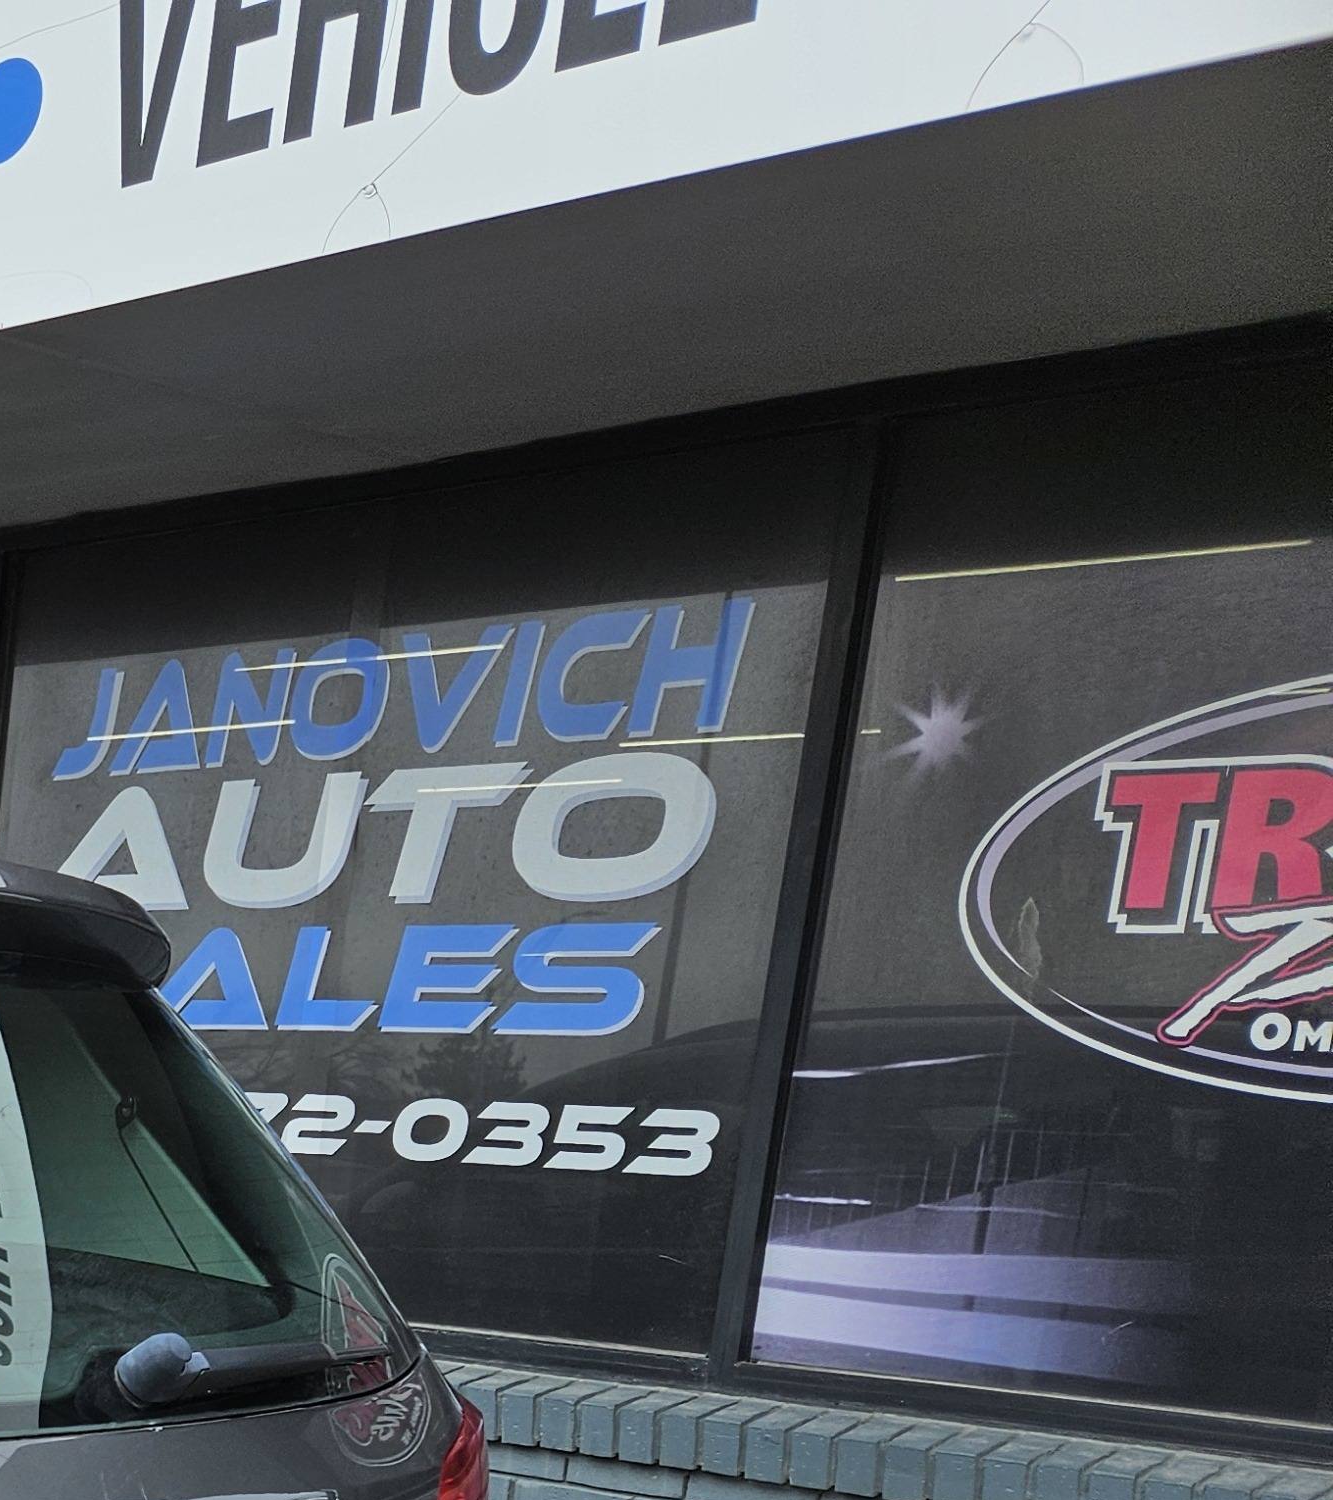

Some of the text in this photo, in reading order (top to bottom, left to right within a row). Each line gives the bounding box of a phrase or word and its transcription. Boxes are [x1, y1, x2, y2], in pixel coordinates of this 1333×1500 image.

[51, 594, 757, 781] JANOVICH
[57, 751, 717, 911] AUTO
[161, 922, 663, 1036] ALES
